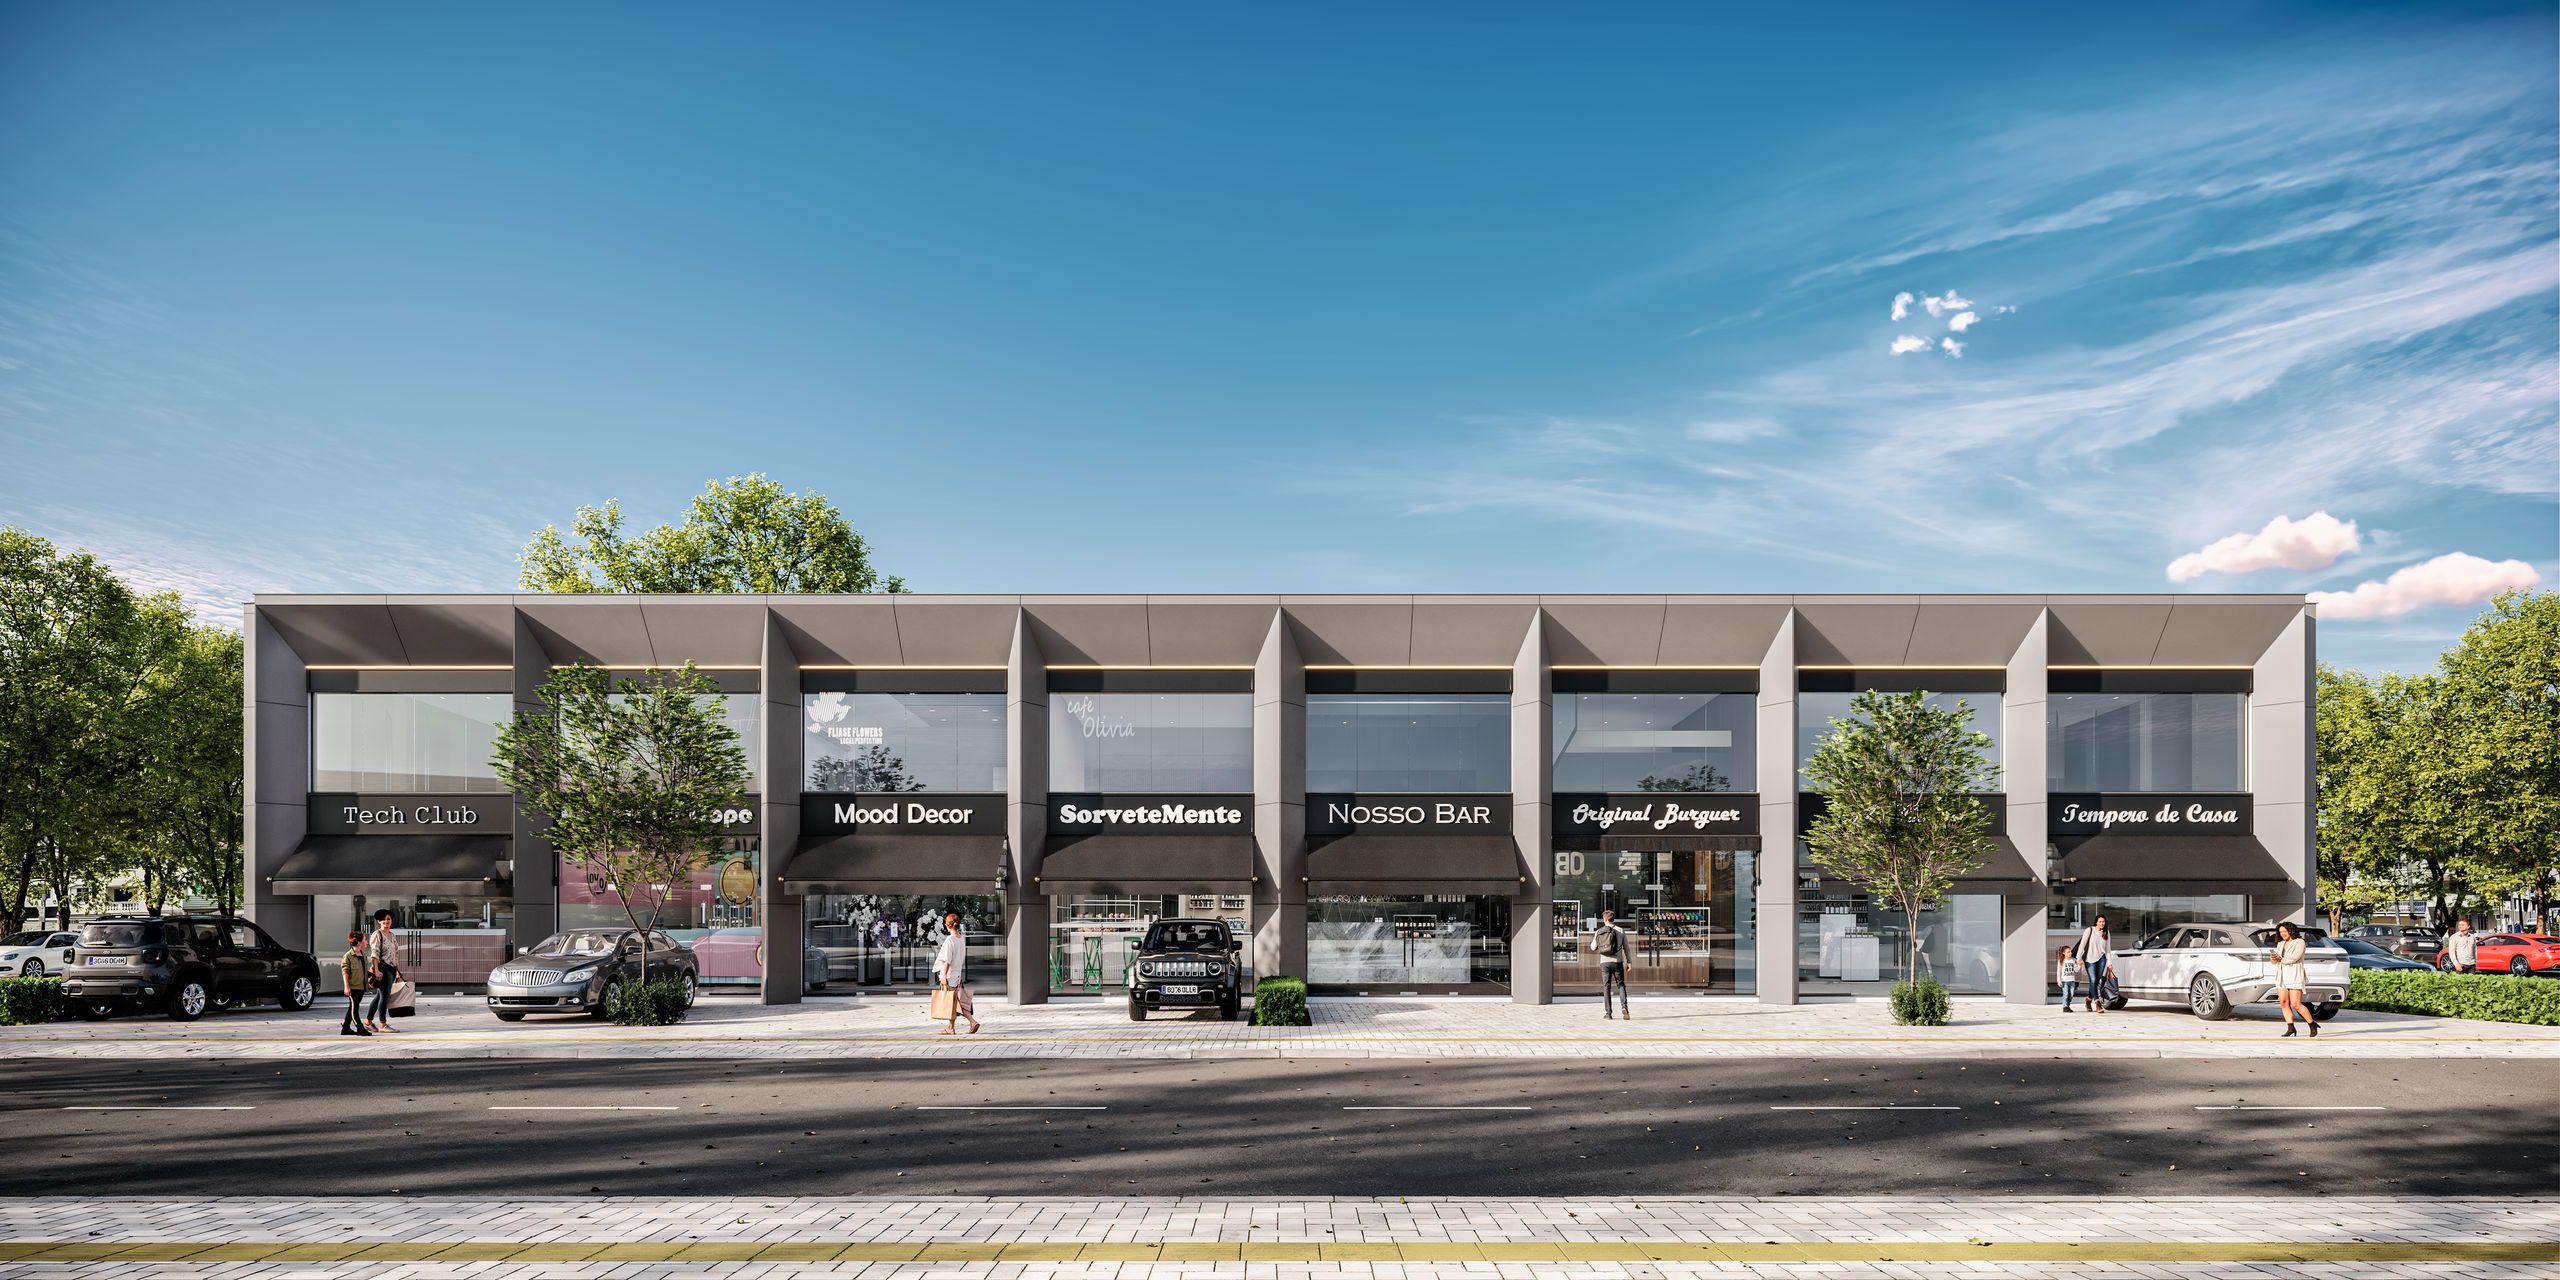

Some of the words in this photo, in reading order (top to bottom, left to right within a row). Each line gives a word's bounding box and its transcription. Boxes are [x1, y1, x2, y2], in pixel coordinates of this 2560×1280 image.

[852, 727, 883, 738] FLOWERS
[1083, 715, 1135, 738] Olivia
[343, 806, 405, 824] Tech
[415, 806, 477, 824] Club
[834, 803, 898, 823] Mood
[908, 803, 972, 823] Decor
[1060, 804, 1242, 824] SorveteMente
[1436, 804, 1490, 823] BAR
[1573, 804, 1652, 829] Original
[1654, 803, 1740, 829] Burguer
[2062, 803, 2149, 829] Tempero
[2155, 803, 2180, 823] de
[2186, 803, 2239, 823] Casa
